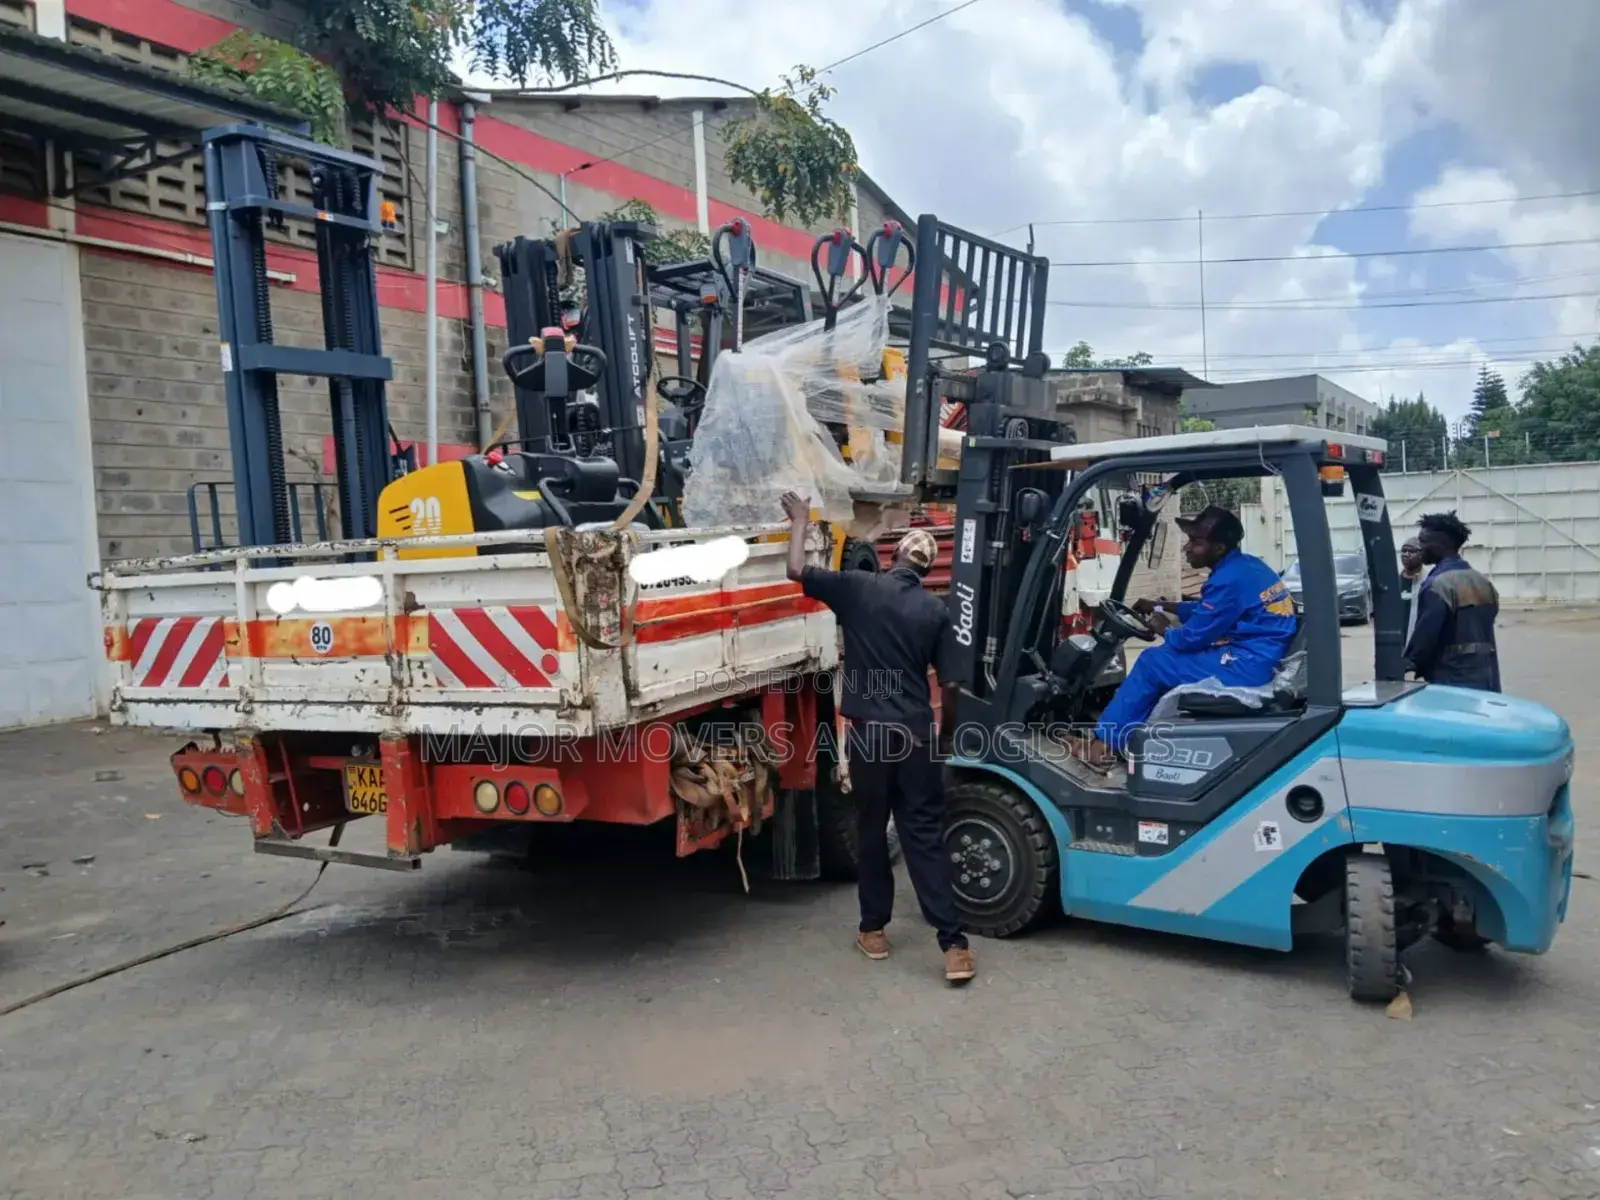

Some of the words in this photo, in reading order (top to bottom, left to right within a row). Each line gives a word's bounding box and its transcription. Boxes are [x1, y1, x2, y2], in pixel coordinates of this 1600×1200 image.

[627, 314, 642, 398] ATCOLIFT
[410, 496, 442, 536] 20
[311, 626, 331, 645] 80
